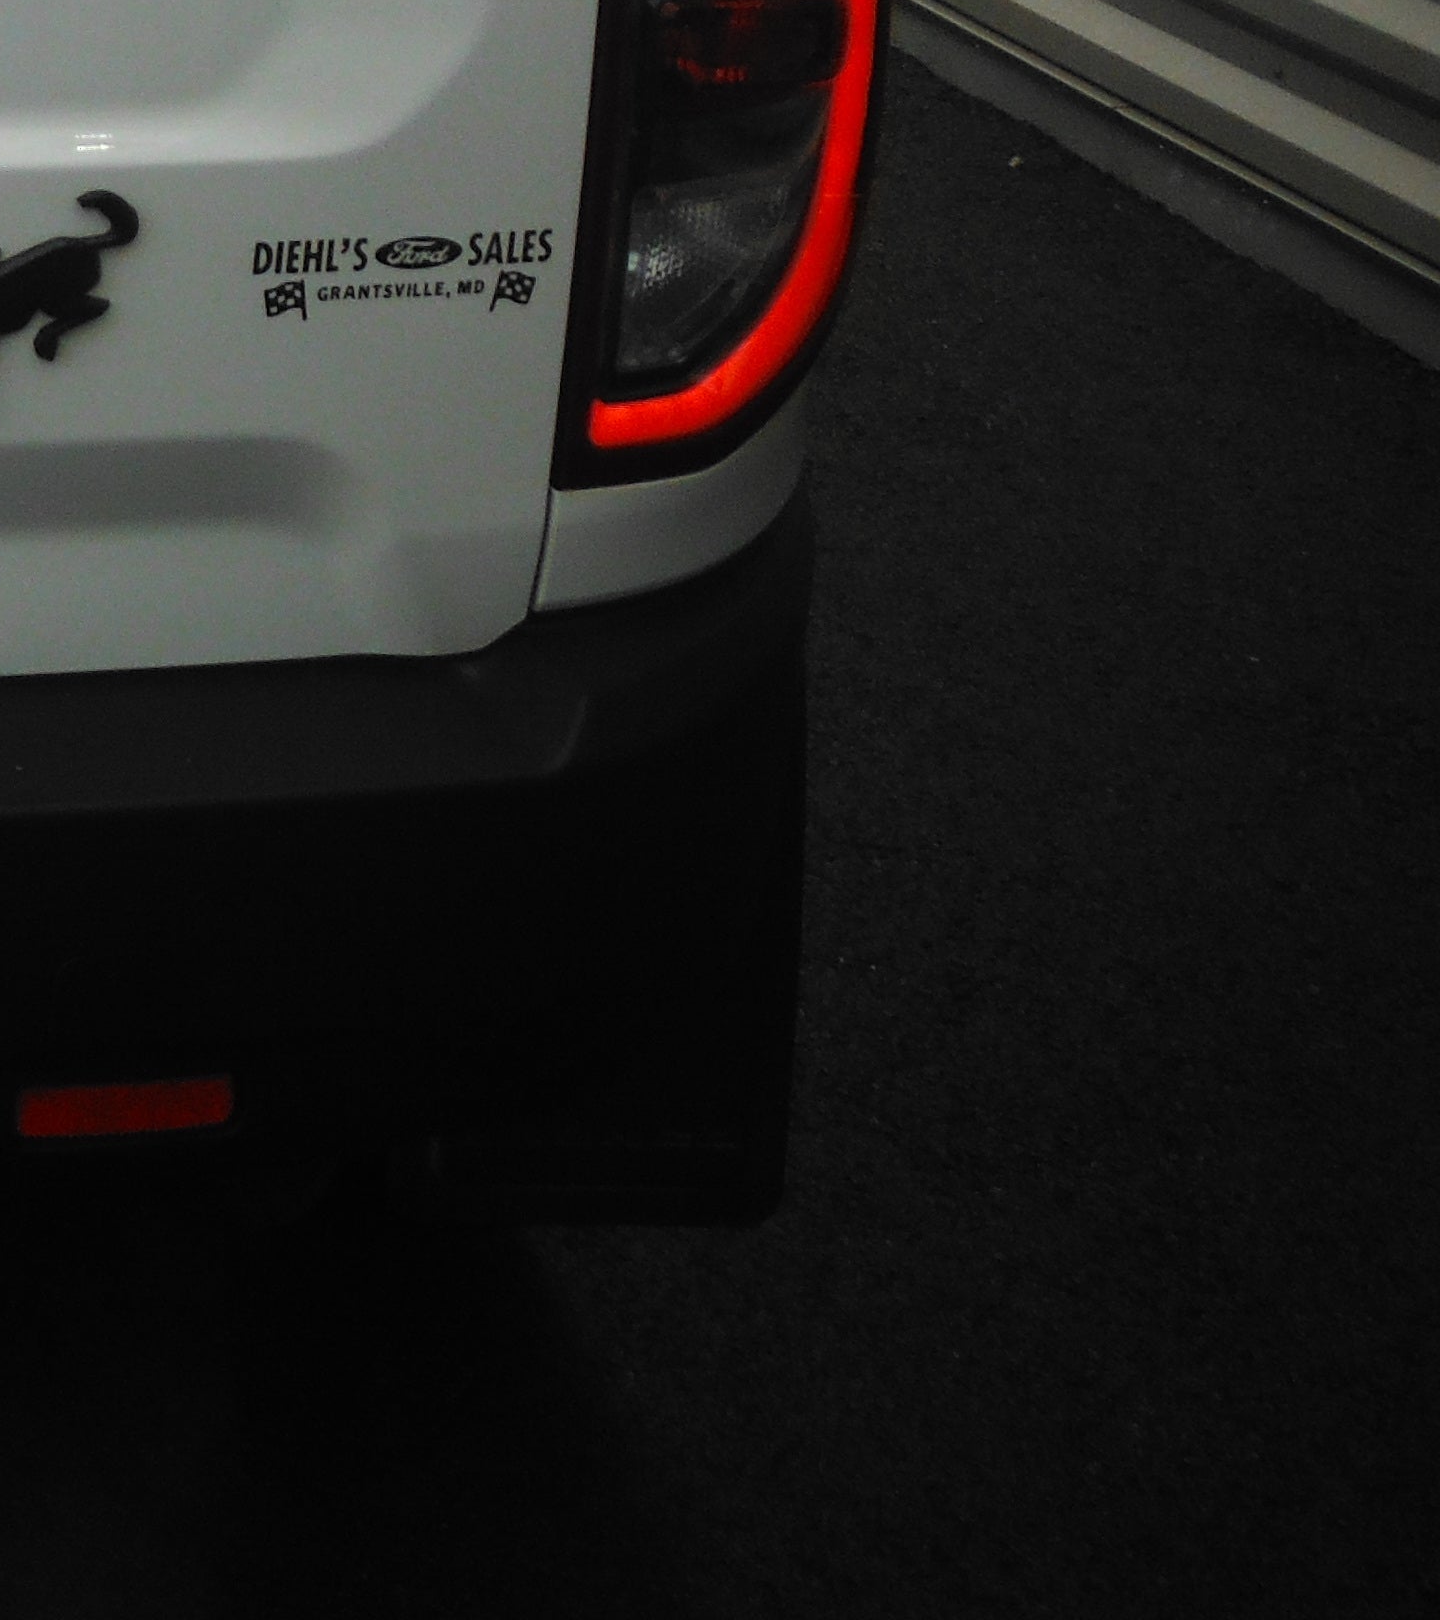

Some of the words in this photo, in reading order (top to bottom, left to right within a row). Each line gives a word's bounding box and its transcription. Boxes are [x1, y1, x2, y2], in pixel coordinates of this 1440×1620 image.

[253, 237, 368, 275] DIEHL'S
[386, 238, 451, 266] Ford
[467, 228, 554, 266] SALES
[317, 279, 451, 301] GRANTSVILLE,
[457, 279, 486, 295] MD
